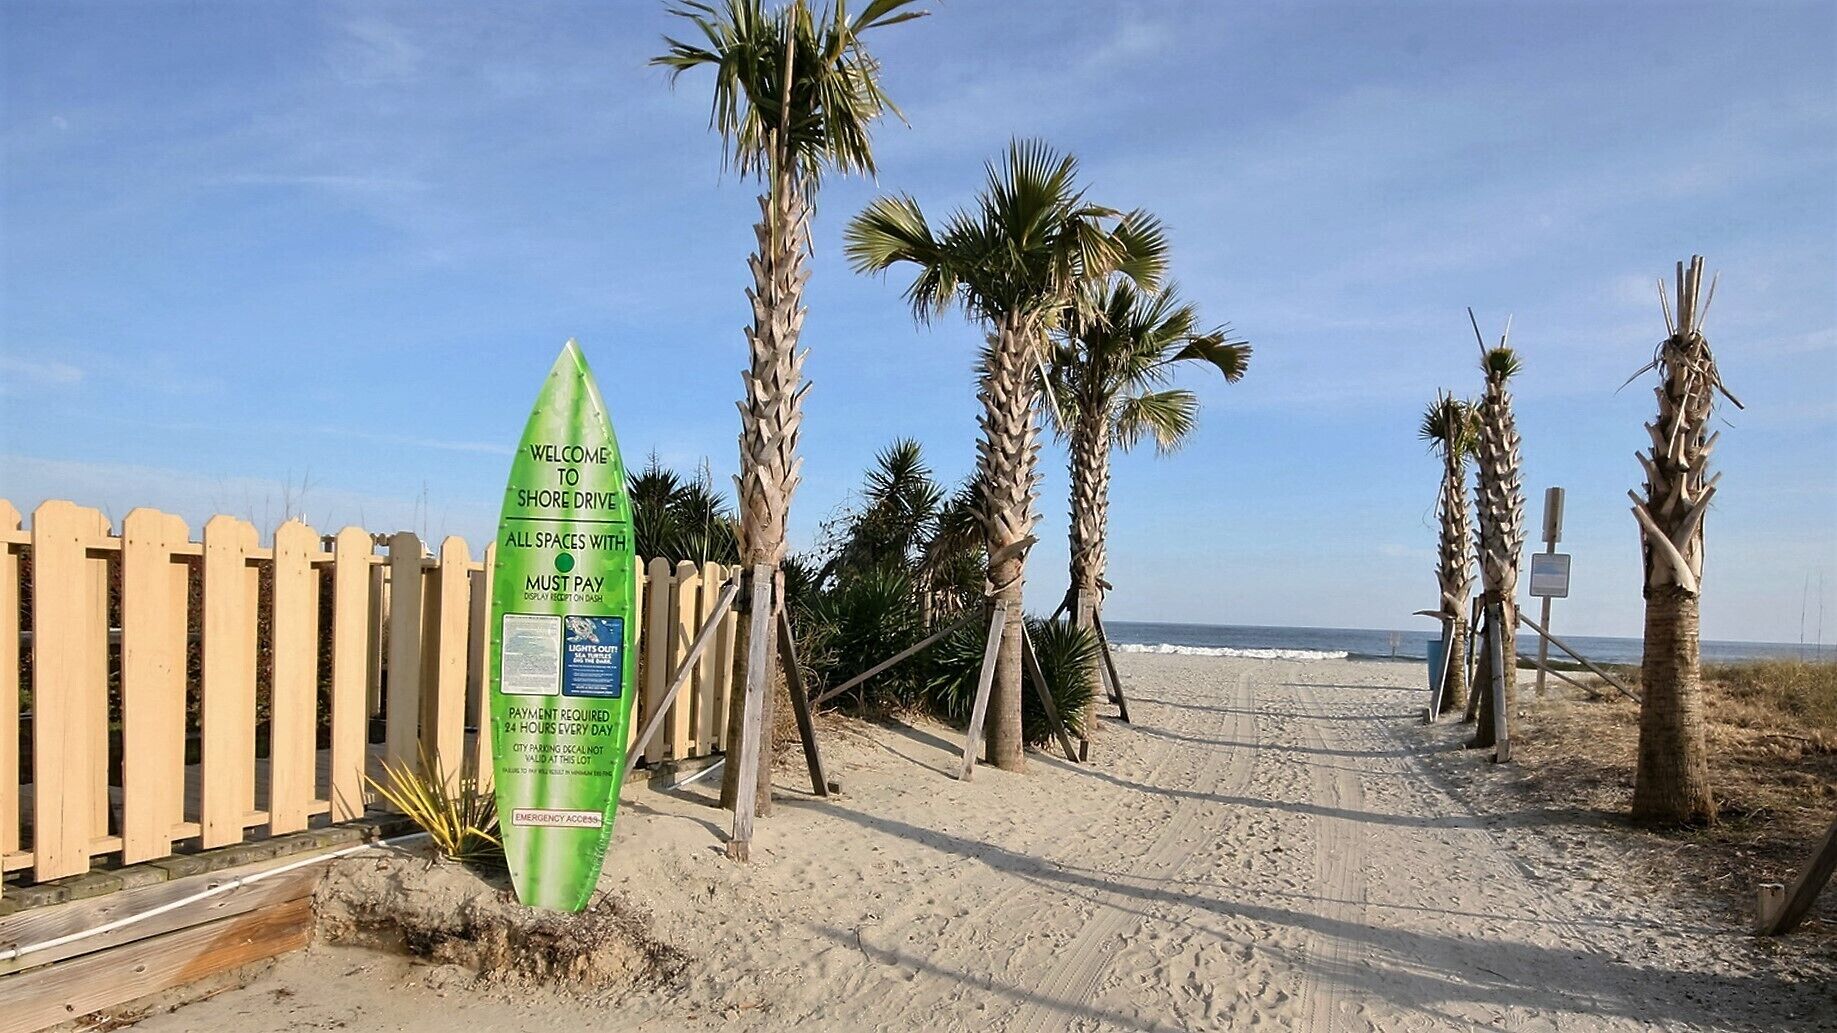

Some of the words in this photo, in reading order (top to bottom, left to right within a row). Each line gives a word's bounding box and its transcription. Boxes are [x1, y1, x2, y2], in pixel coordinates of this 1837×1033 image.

[530, 444, 608, 464] WELCOME
[557, 468, 579, 486] TO
[518, 490, 570, 508] SHORE
[574, 492, 616, 510] DRIVE
[505, 532, 532, 548] ALL
[536, 532, 586, 550] SPACES
[589, 535, 626, 551] WITH
[525, 575, 569, 591] MUST
[574, 576, 604, 593] PAY
[524, 592, 549, 600] DISPLAY
[551, 593, 572, 601] RECEIPT
[585, 594, 603, 602] DASH
[569, 644, 596, 653] LIGHTS
[598, 645, 618, 653] OUT!
[509, 707, 558, 720] PAYMENT
[561, 708, 610, 722] REQUIRED
[504, 722, 516, 733] 24
[520, 722, 556, 734] HOURS
[558, 723, 589, 736] EVERY
[591, 724, 613, 736] DAY
[513, 744, 528, 752] CITY
[530, 744, 561, 754] PARKING
[563, 745, 586, 754] DECAL
[587, 746, 603, 755] NOT
[525, 755, 547, 763] VALID
[548, 756, 559, 764] AT
[560, 756, 575, 765] THIS
[577, 756, 592, 765] LOT
[515, 813, 565, 823] EMERGENCY
[566, 815, 599, 824] ACCESS
